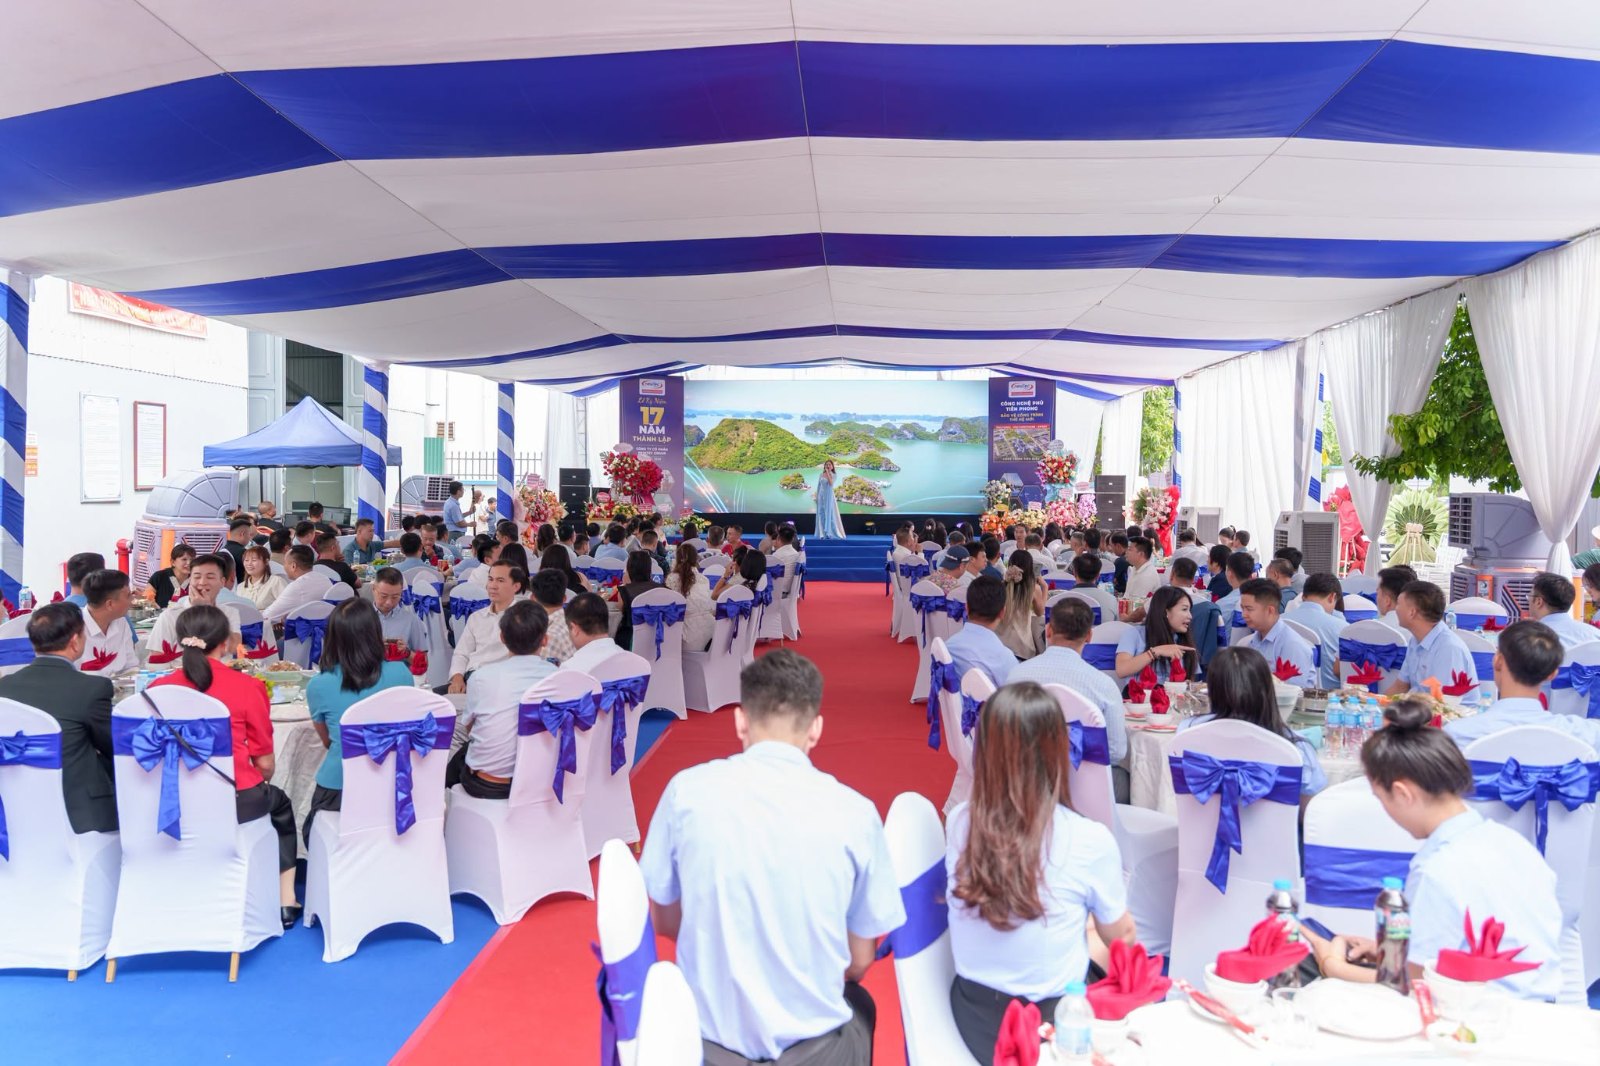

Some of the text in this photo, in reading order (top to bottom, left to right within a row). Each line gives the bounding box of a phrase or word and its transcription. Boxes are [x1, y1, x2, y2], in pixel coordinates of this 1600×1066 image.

[639, 406, 665, 426] 17
[638, 423, 666, 435] NĂM
[658, 436, 672, 444] LẬP
